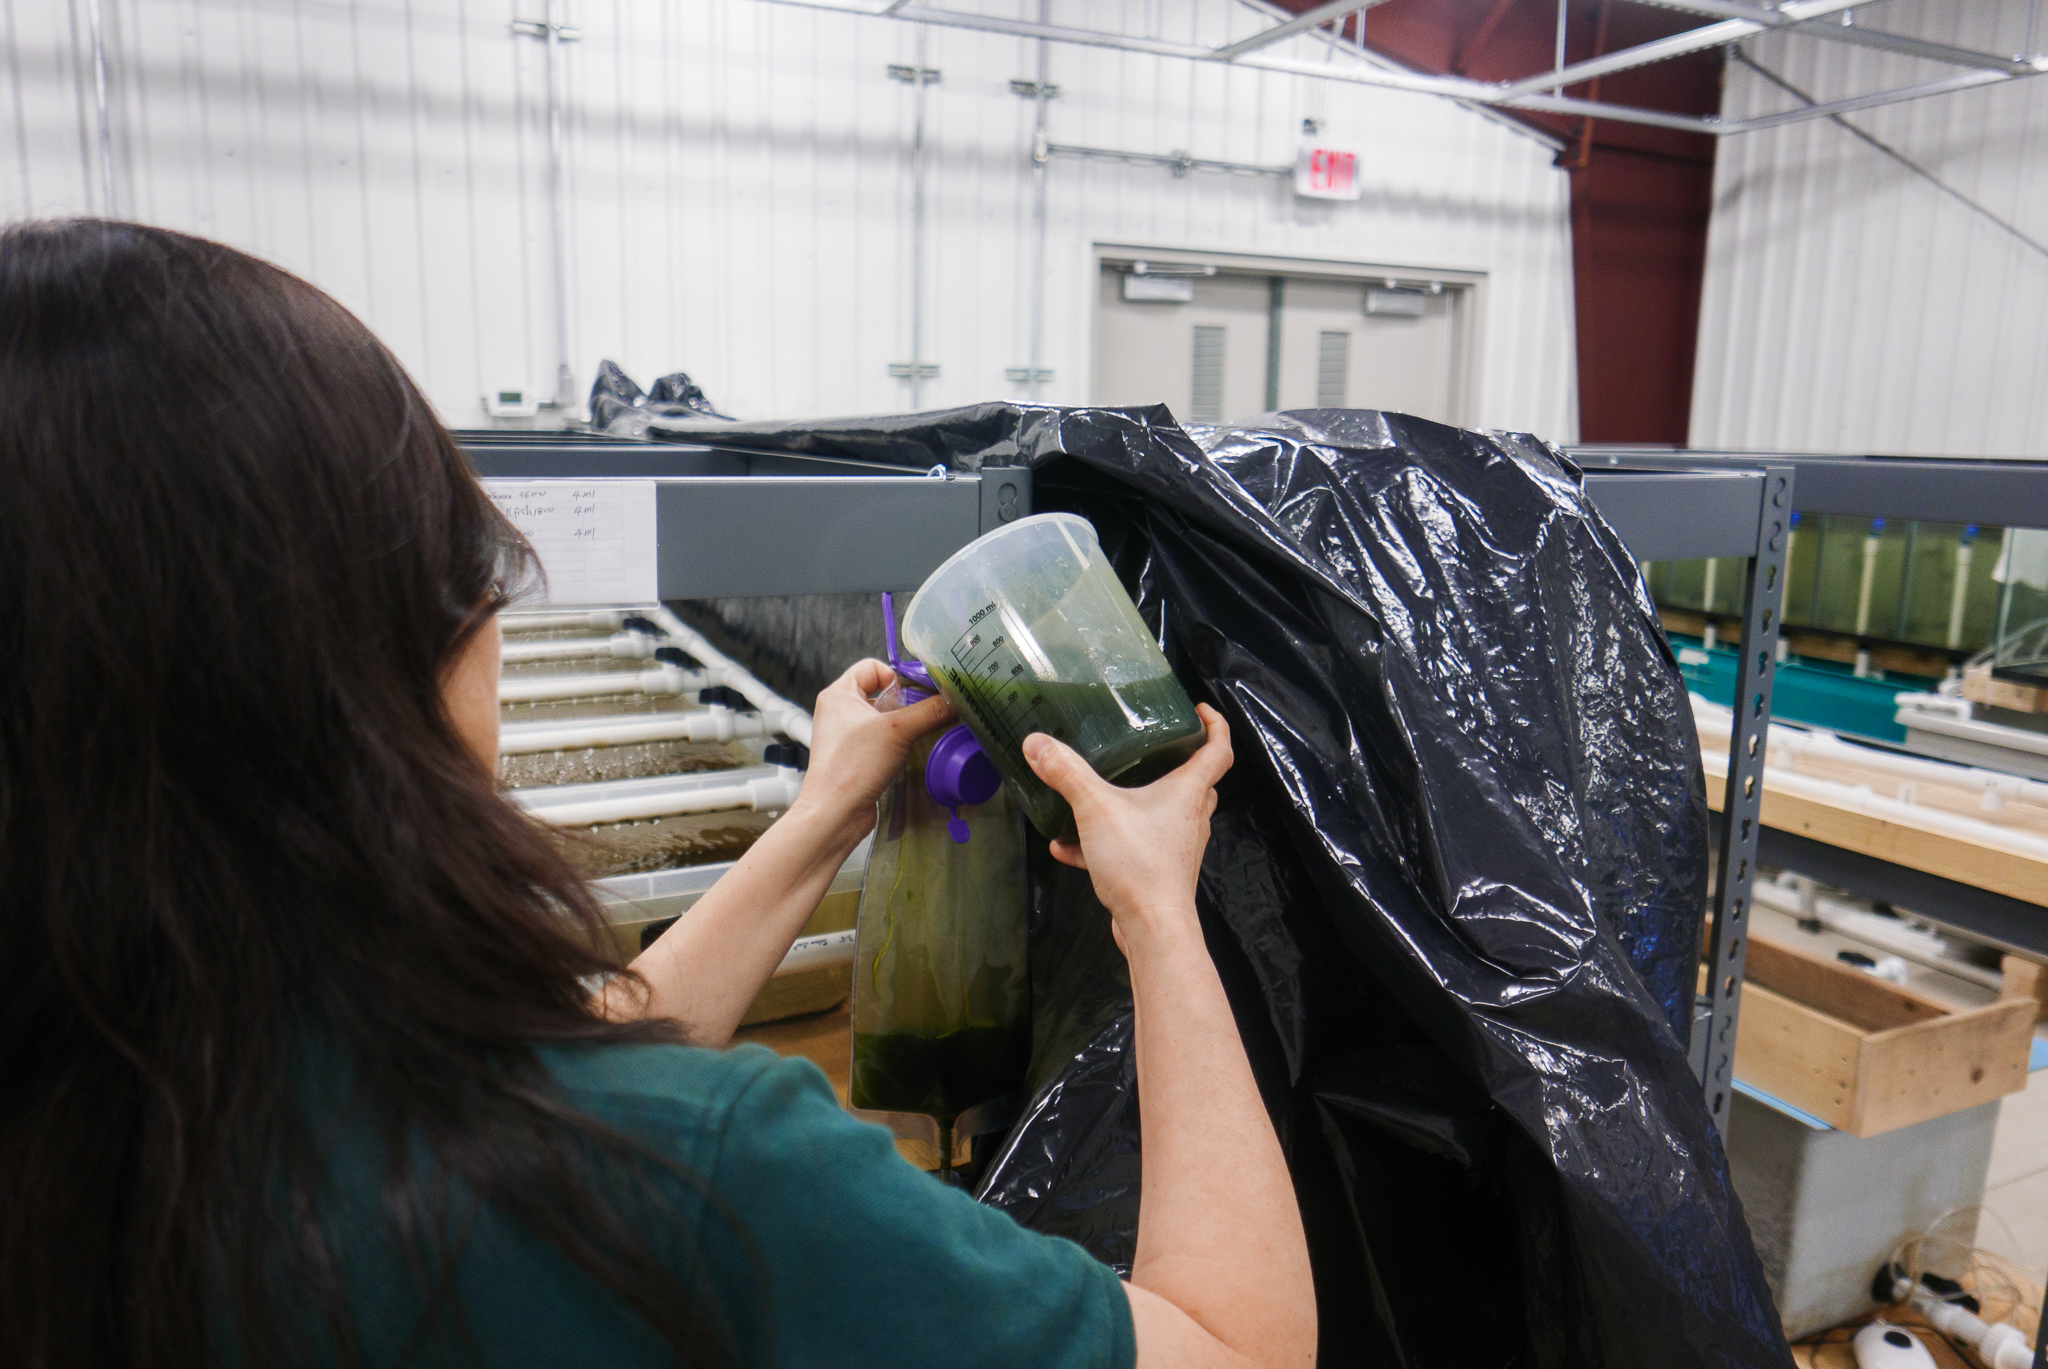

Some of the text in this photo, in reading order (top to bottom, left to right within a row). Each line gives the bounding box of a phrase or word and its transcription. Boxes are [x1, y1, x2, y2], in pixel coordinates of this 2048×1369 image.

[1310, 149, 1354, 191] EXIT
[968, 608, 986, 625] 1000
[969, 634, 981, 647] 900
[992, 635, 1004, 648] 800
[988, 661, 999, 673] 700
[1011, 663, 1023, 676] 600
[947, 667, 1002, 743] NALGENE
